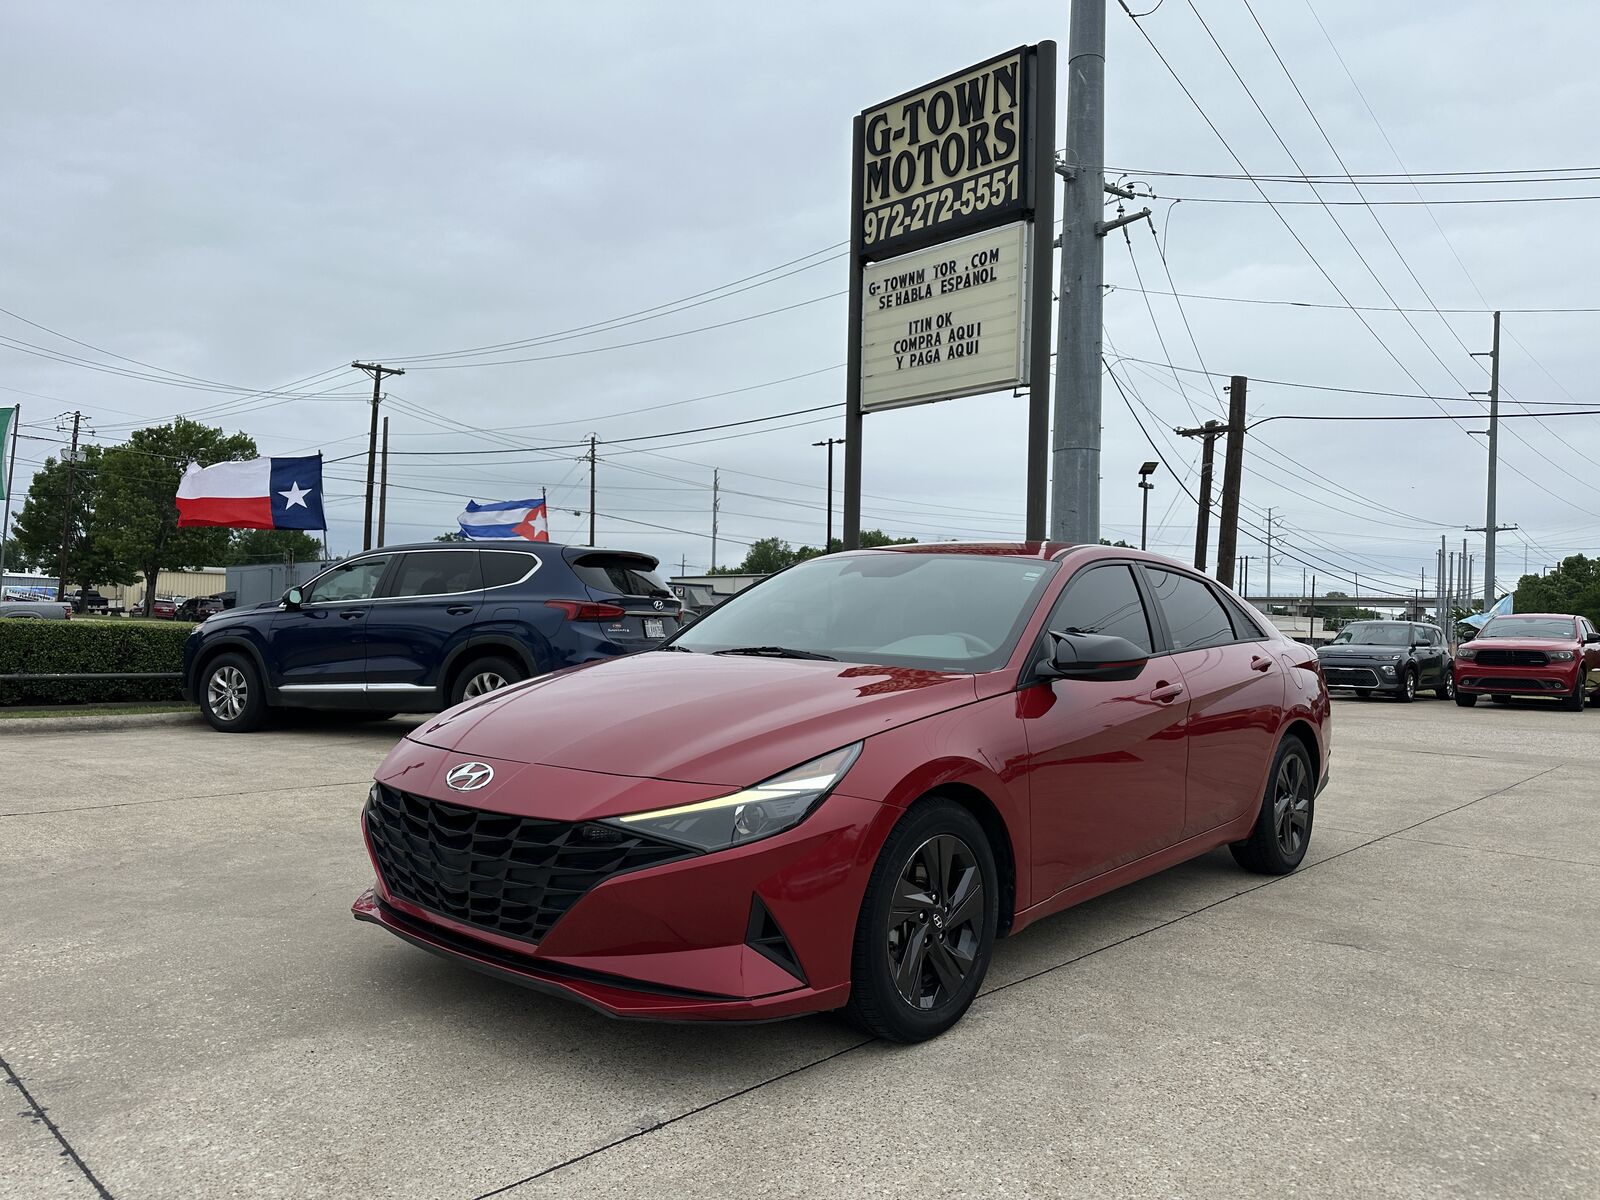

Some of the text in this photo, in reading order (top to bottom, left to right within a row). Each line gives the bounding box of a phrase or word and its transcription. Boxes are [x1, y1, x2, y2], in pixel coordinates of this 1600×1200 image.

[866, 61, 1018, 156] G-TOWN
[865, 111, 1016, 204] MOTORS
[864, 164, 1019, 245] 972-272-5551
[893, 322, 981, 354] COMPRA AQUI
[908, 311, 952, 335] ITIN OK
[896, 340, 979, 370] Y PAGA AQUI
